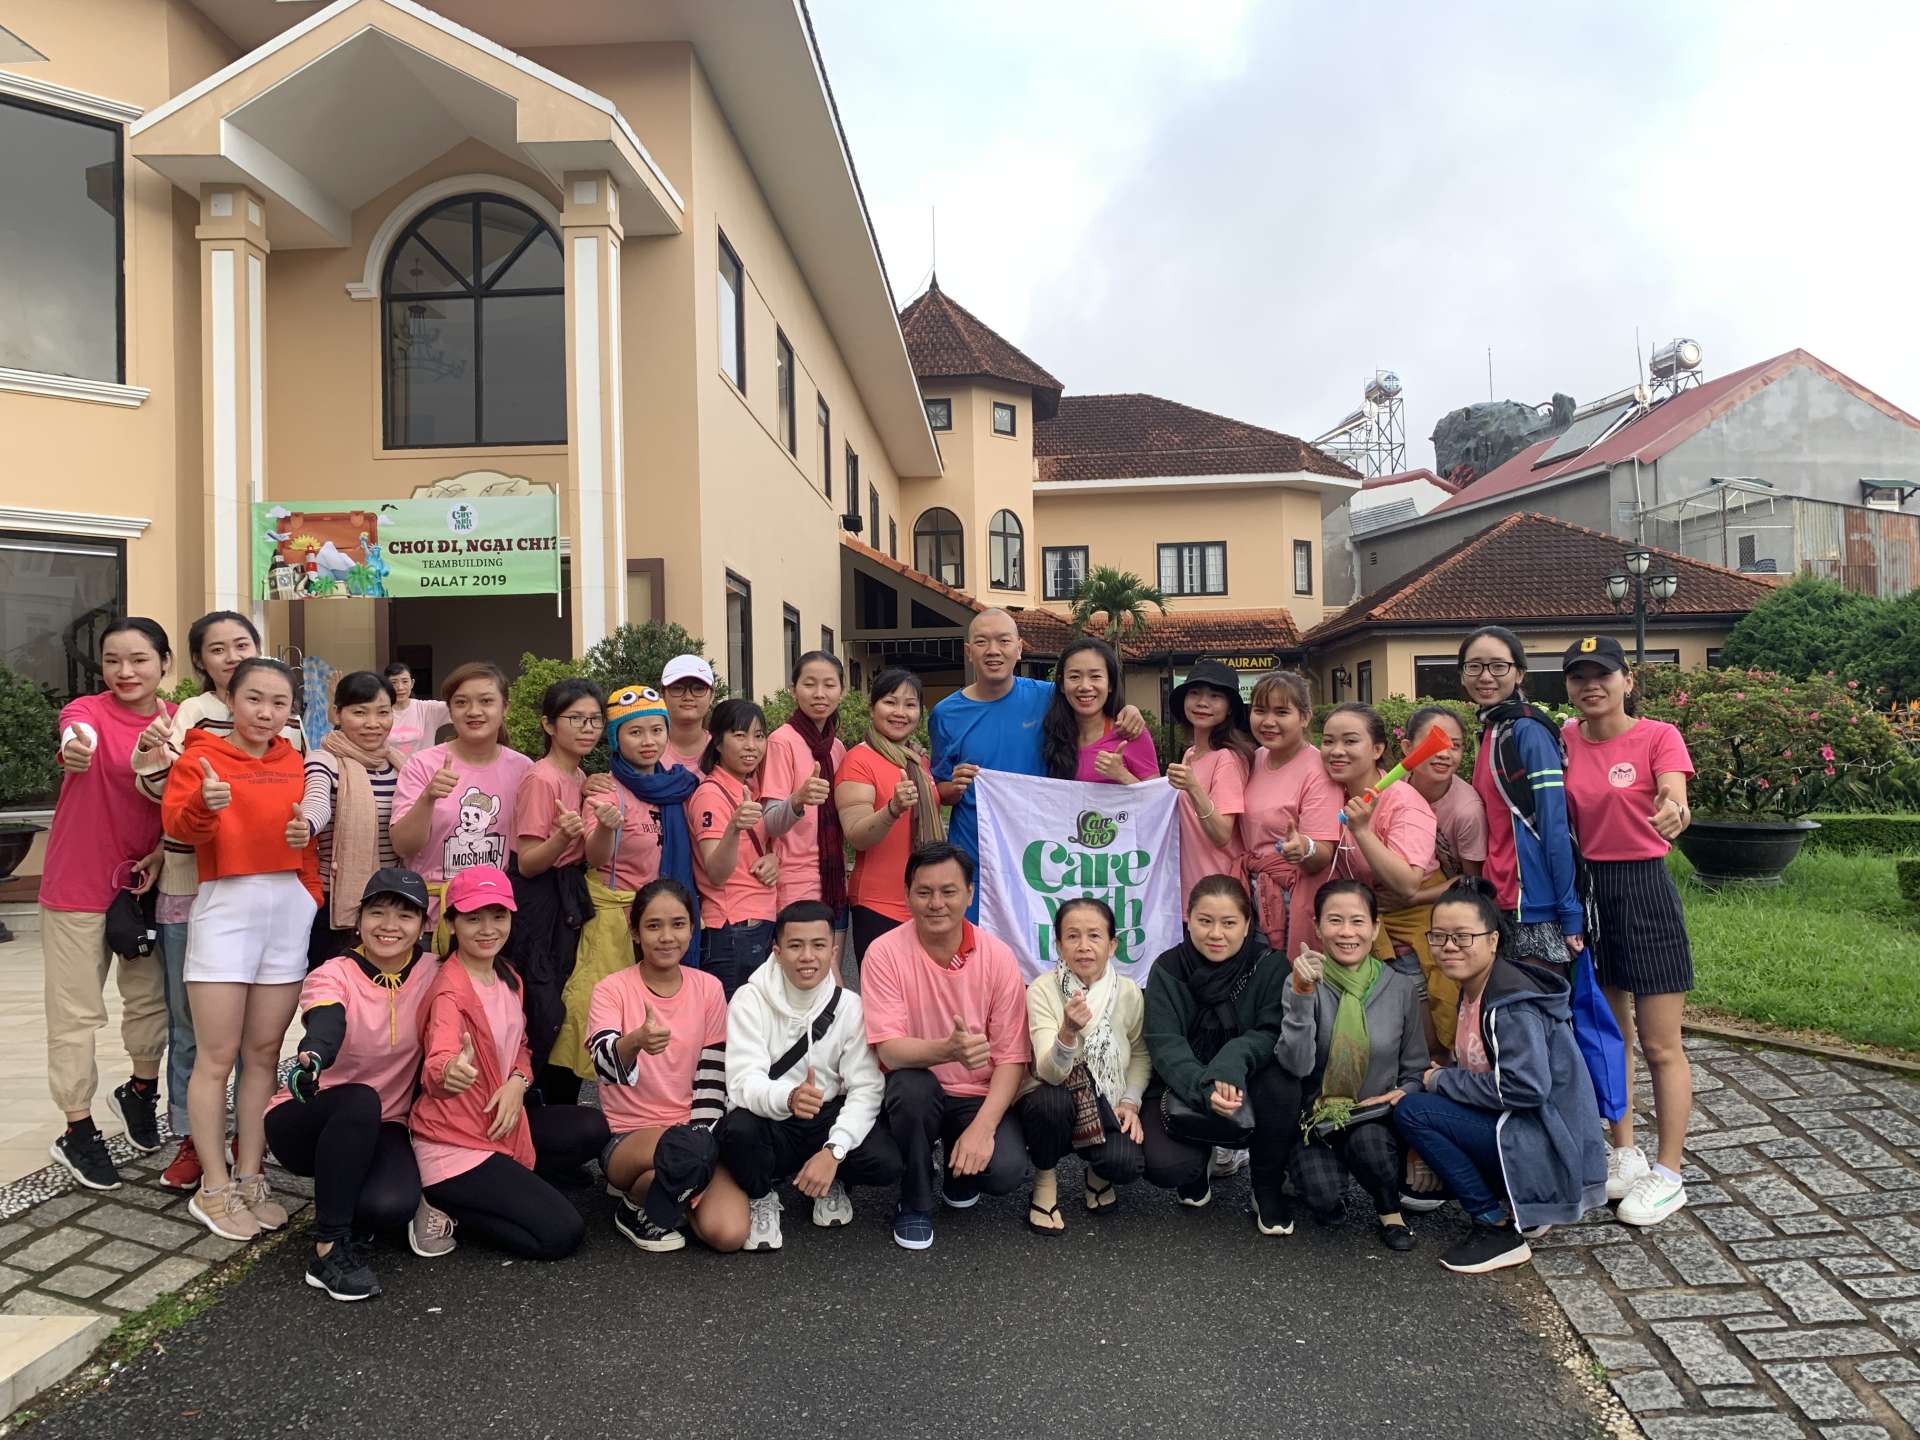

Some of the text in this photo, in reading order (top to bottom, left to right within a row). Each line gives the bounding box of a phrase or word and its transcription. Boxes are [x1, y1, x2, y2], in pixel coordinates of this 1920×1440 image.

[389, 539, 434, 555] CHƠI
[466, 538, 513, 555] NGẠI
[516, 536, 557, 551] CHI?
[422, 558, 503, 569] TEAMBUILDING
[420, 574, 507, 588] DALAT 2019
[1213, 656, 1273, 668] TAURANT
[702, 811, 713, 828] 3
[1022, 840, 1151, 893] Care
